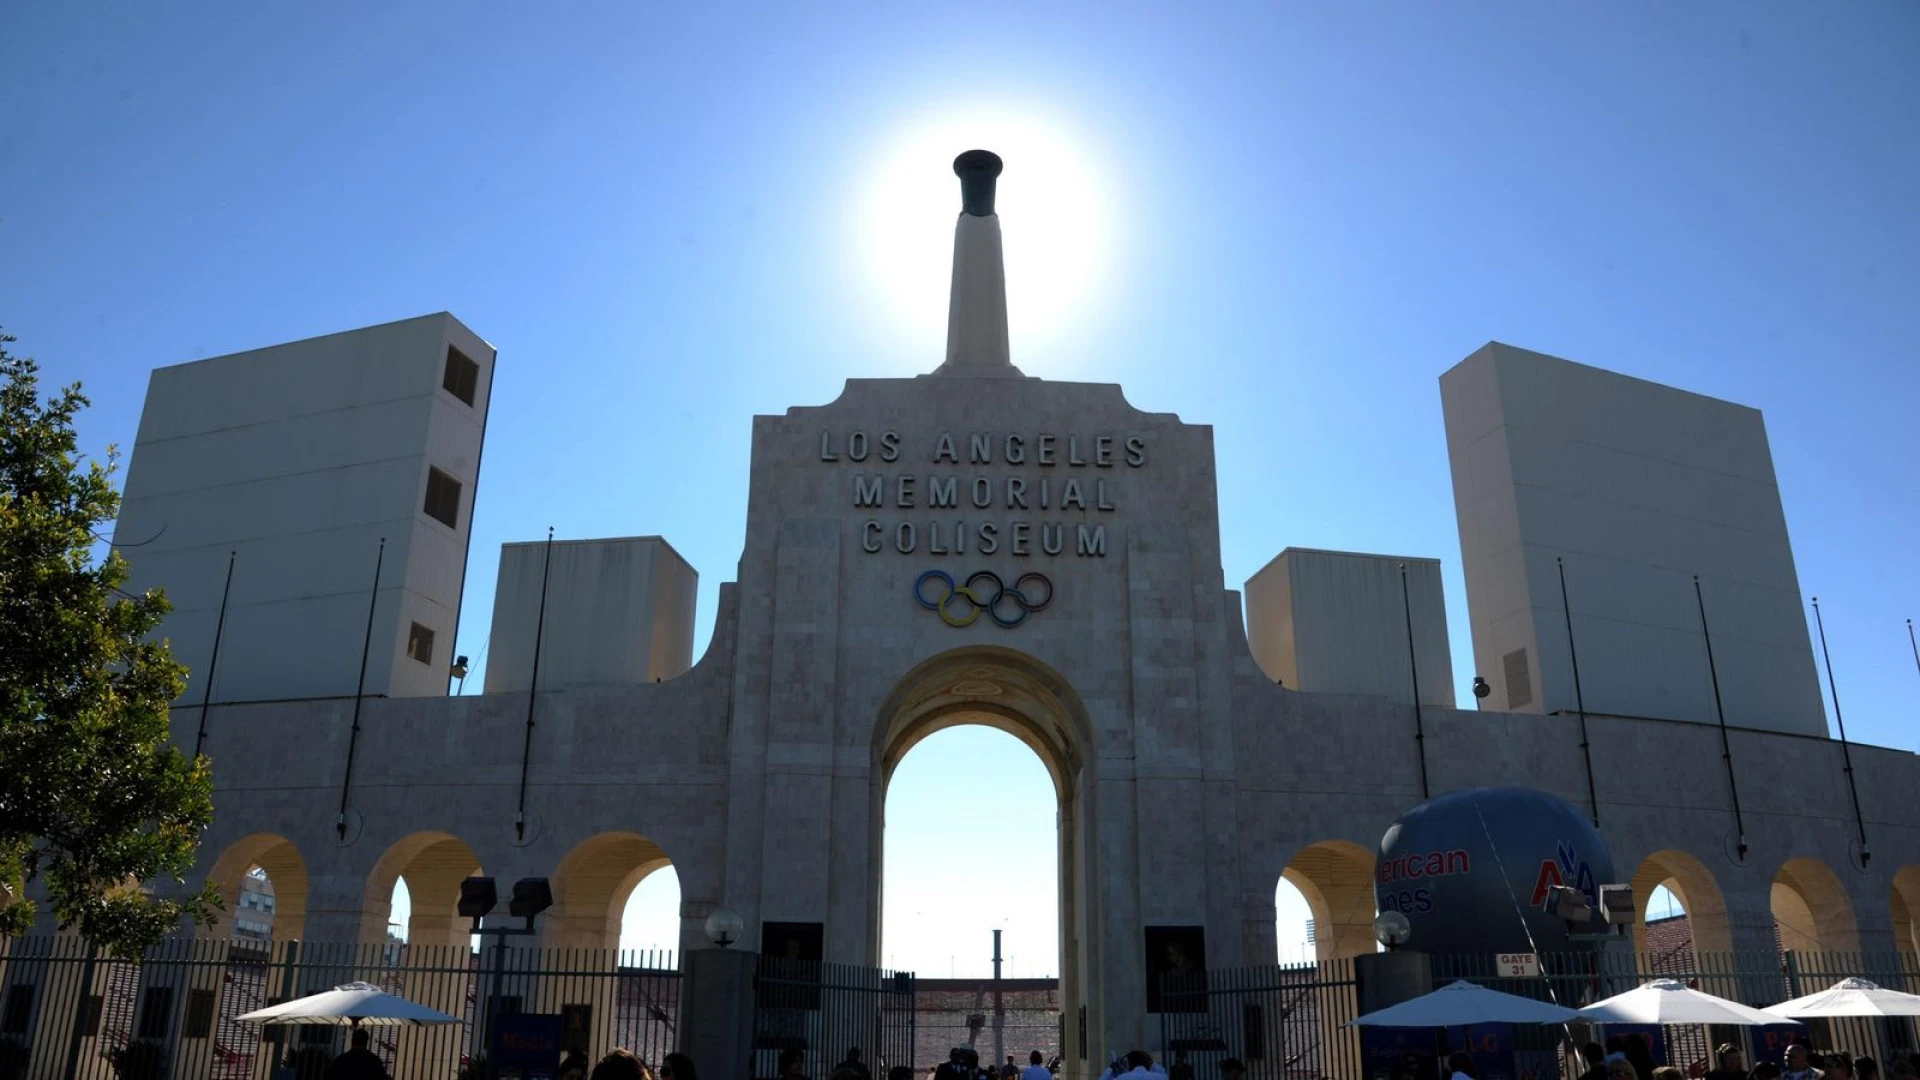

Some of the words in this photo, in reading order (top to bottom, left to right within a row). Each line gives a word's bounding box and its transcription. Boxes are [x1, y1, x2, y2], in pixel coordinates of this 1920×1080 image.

[821, 431, 900, 462] LOS
[934, 431, 1145, 468] ANGELES
[854, 474, 1115, 511] MEMORIAL
[861, 520, 1106, 557] COLISEUM
[1501, 954, 1533, 964] GATE
